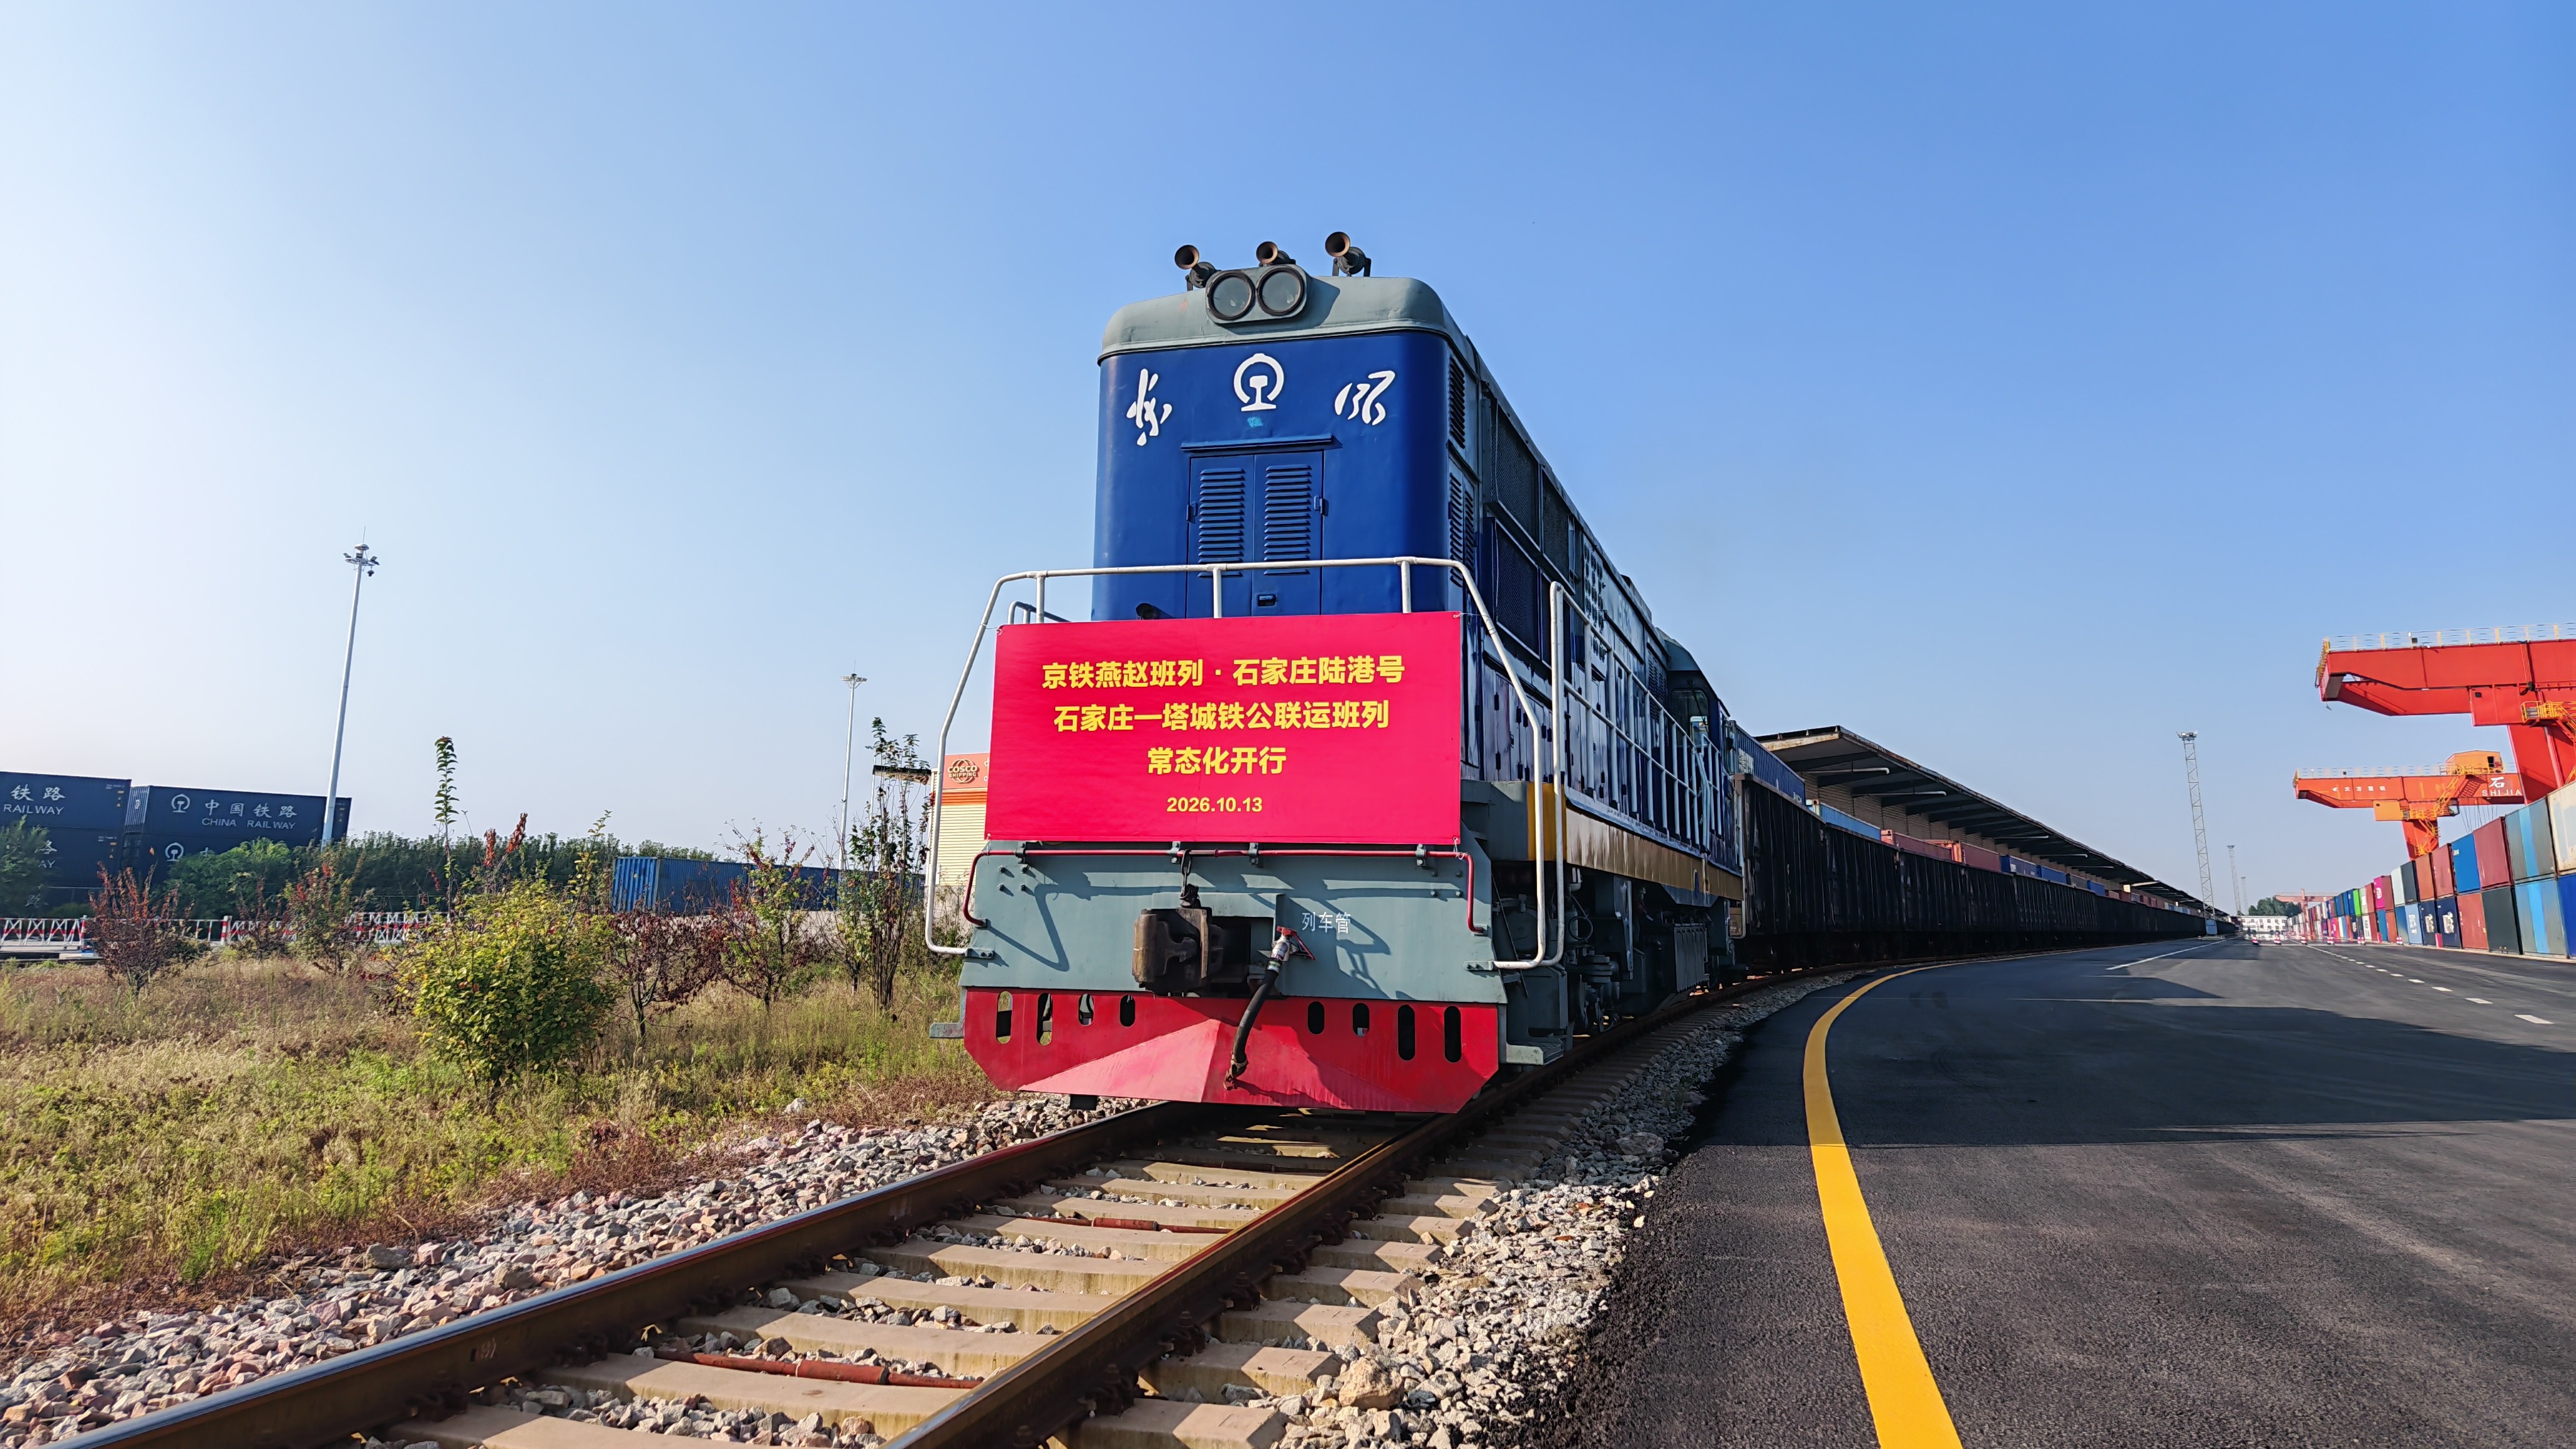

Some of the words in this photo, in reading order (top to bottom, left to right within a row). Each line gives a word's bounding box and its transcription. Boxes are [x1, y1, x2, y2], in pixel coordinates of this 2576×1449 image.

[1147, 746, 1287, 775] 常态化开行
[947, 765, 978, 773] COSCO
[10, 784, 65, 801] 铁路
[3, 804, 64, 815] RAILWAY
[204, 799, 297, 818] 中国铁路
[1167, 797, 1262, 812] 2026.10.13
[201, 818, 237, 827] CHINA
[247, 819, 296, 830] RAILWAY
[1301, 911, 1352, 934] 列车管
